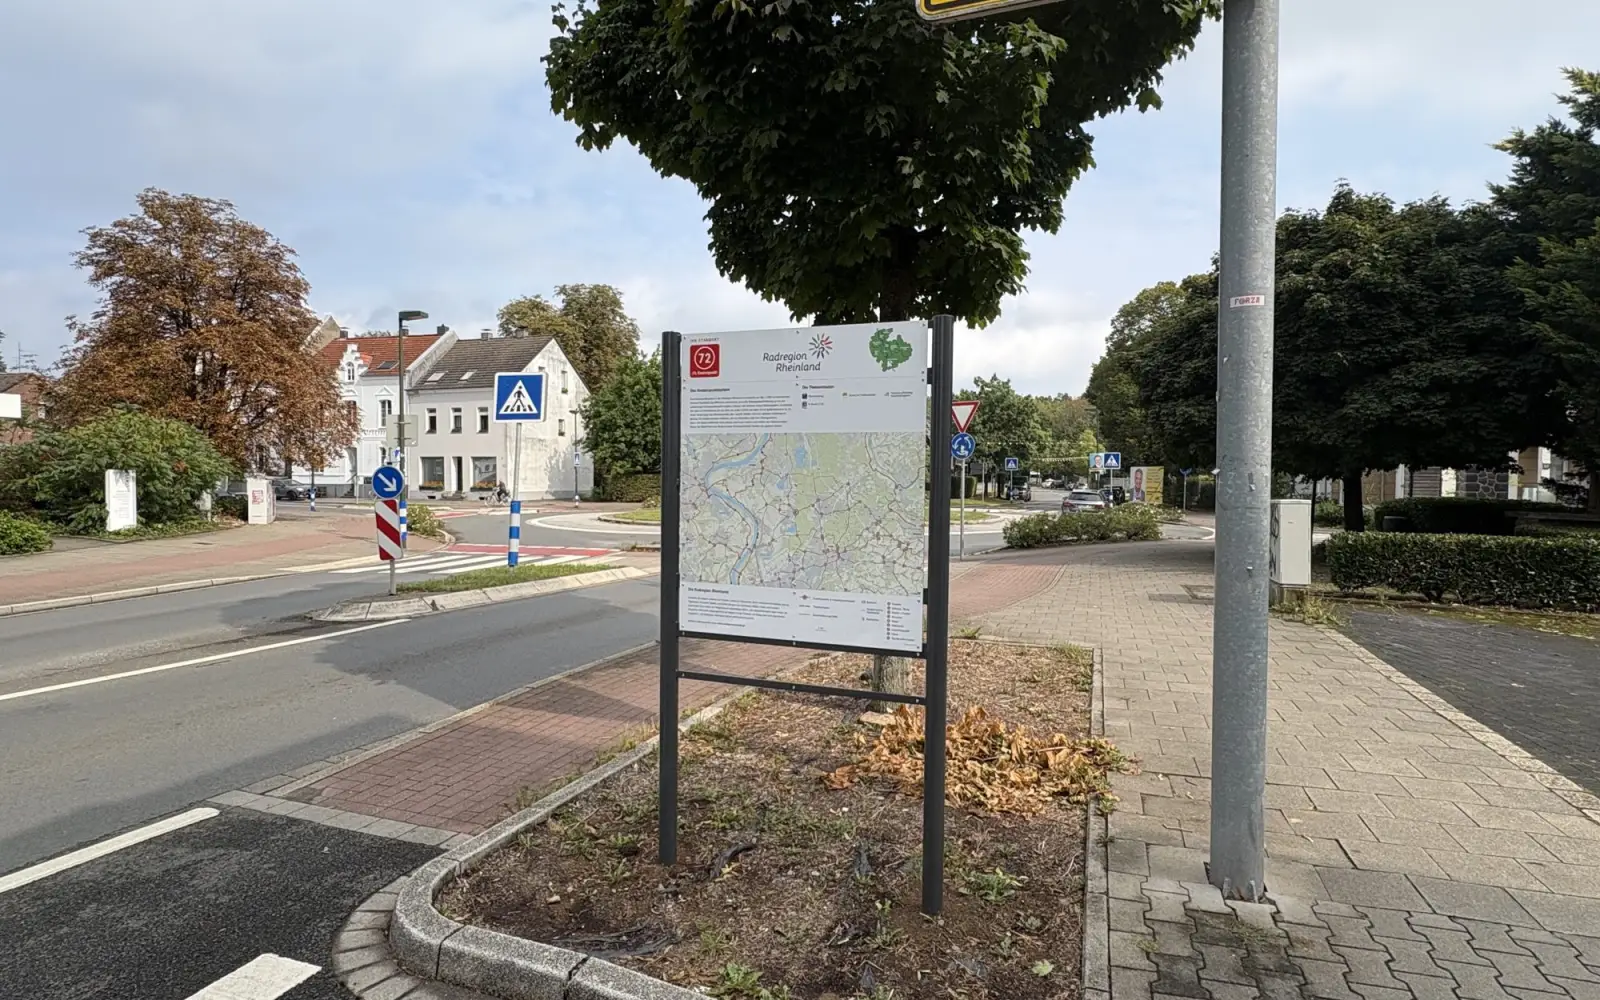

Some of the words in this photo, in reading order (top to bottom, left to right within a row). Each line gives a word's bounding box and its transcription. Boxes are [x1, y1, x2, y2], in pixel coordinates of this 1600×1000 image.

[698, 353, 711, 364] 72
[762, 351, 808, 364] Radregion
[776, 361, 821, 373] Rheinland
